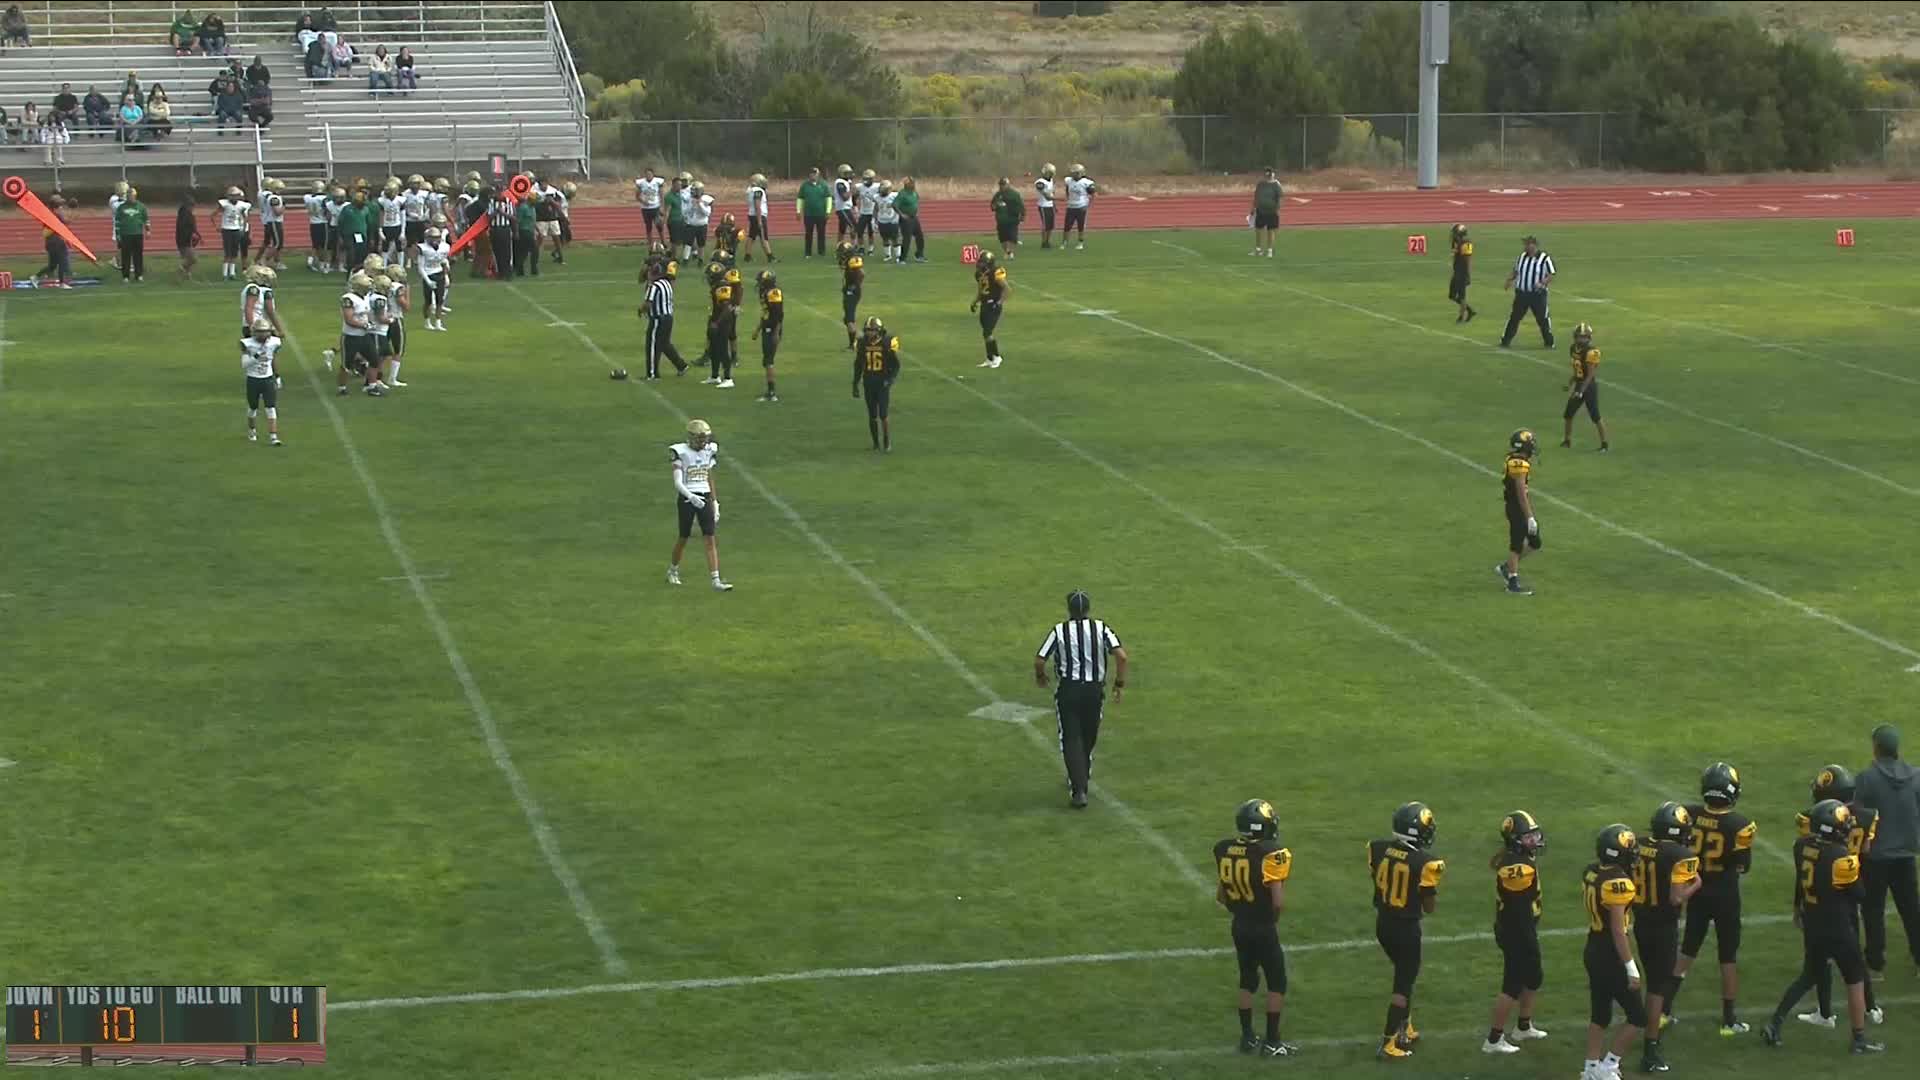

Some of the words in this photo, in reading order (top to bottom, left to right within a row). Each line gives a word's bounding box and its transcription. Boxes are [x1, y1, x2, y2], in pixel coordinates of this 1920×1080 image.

[1410, 238, 1424, 252] 20
[964, 247, 978, 261] 30
[866, 351, 882, 371] 16
[1507, 866, 1524, 880] 24
[1846, 859, 1855, 871] 2
[1220, 857, 1255, 902] 90
[1376, 857, 1410, 907] 40
[1802, 860, 1815, 904] 2
